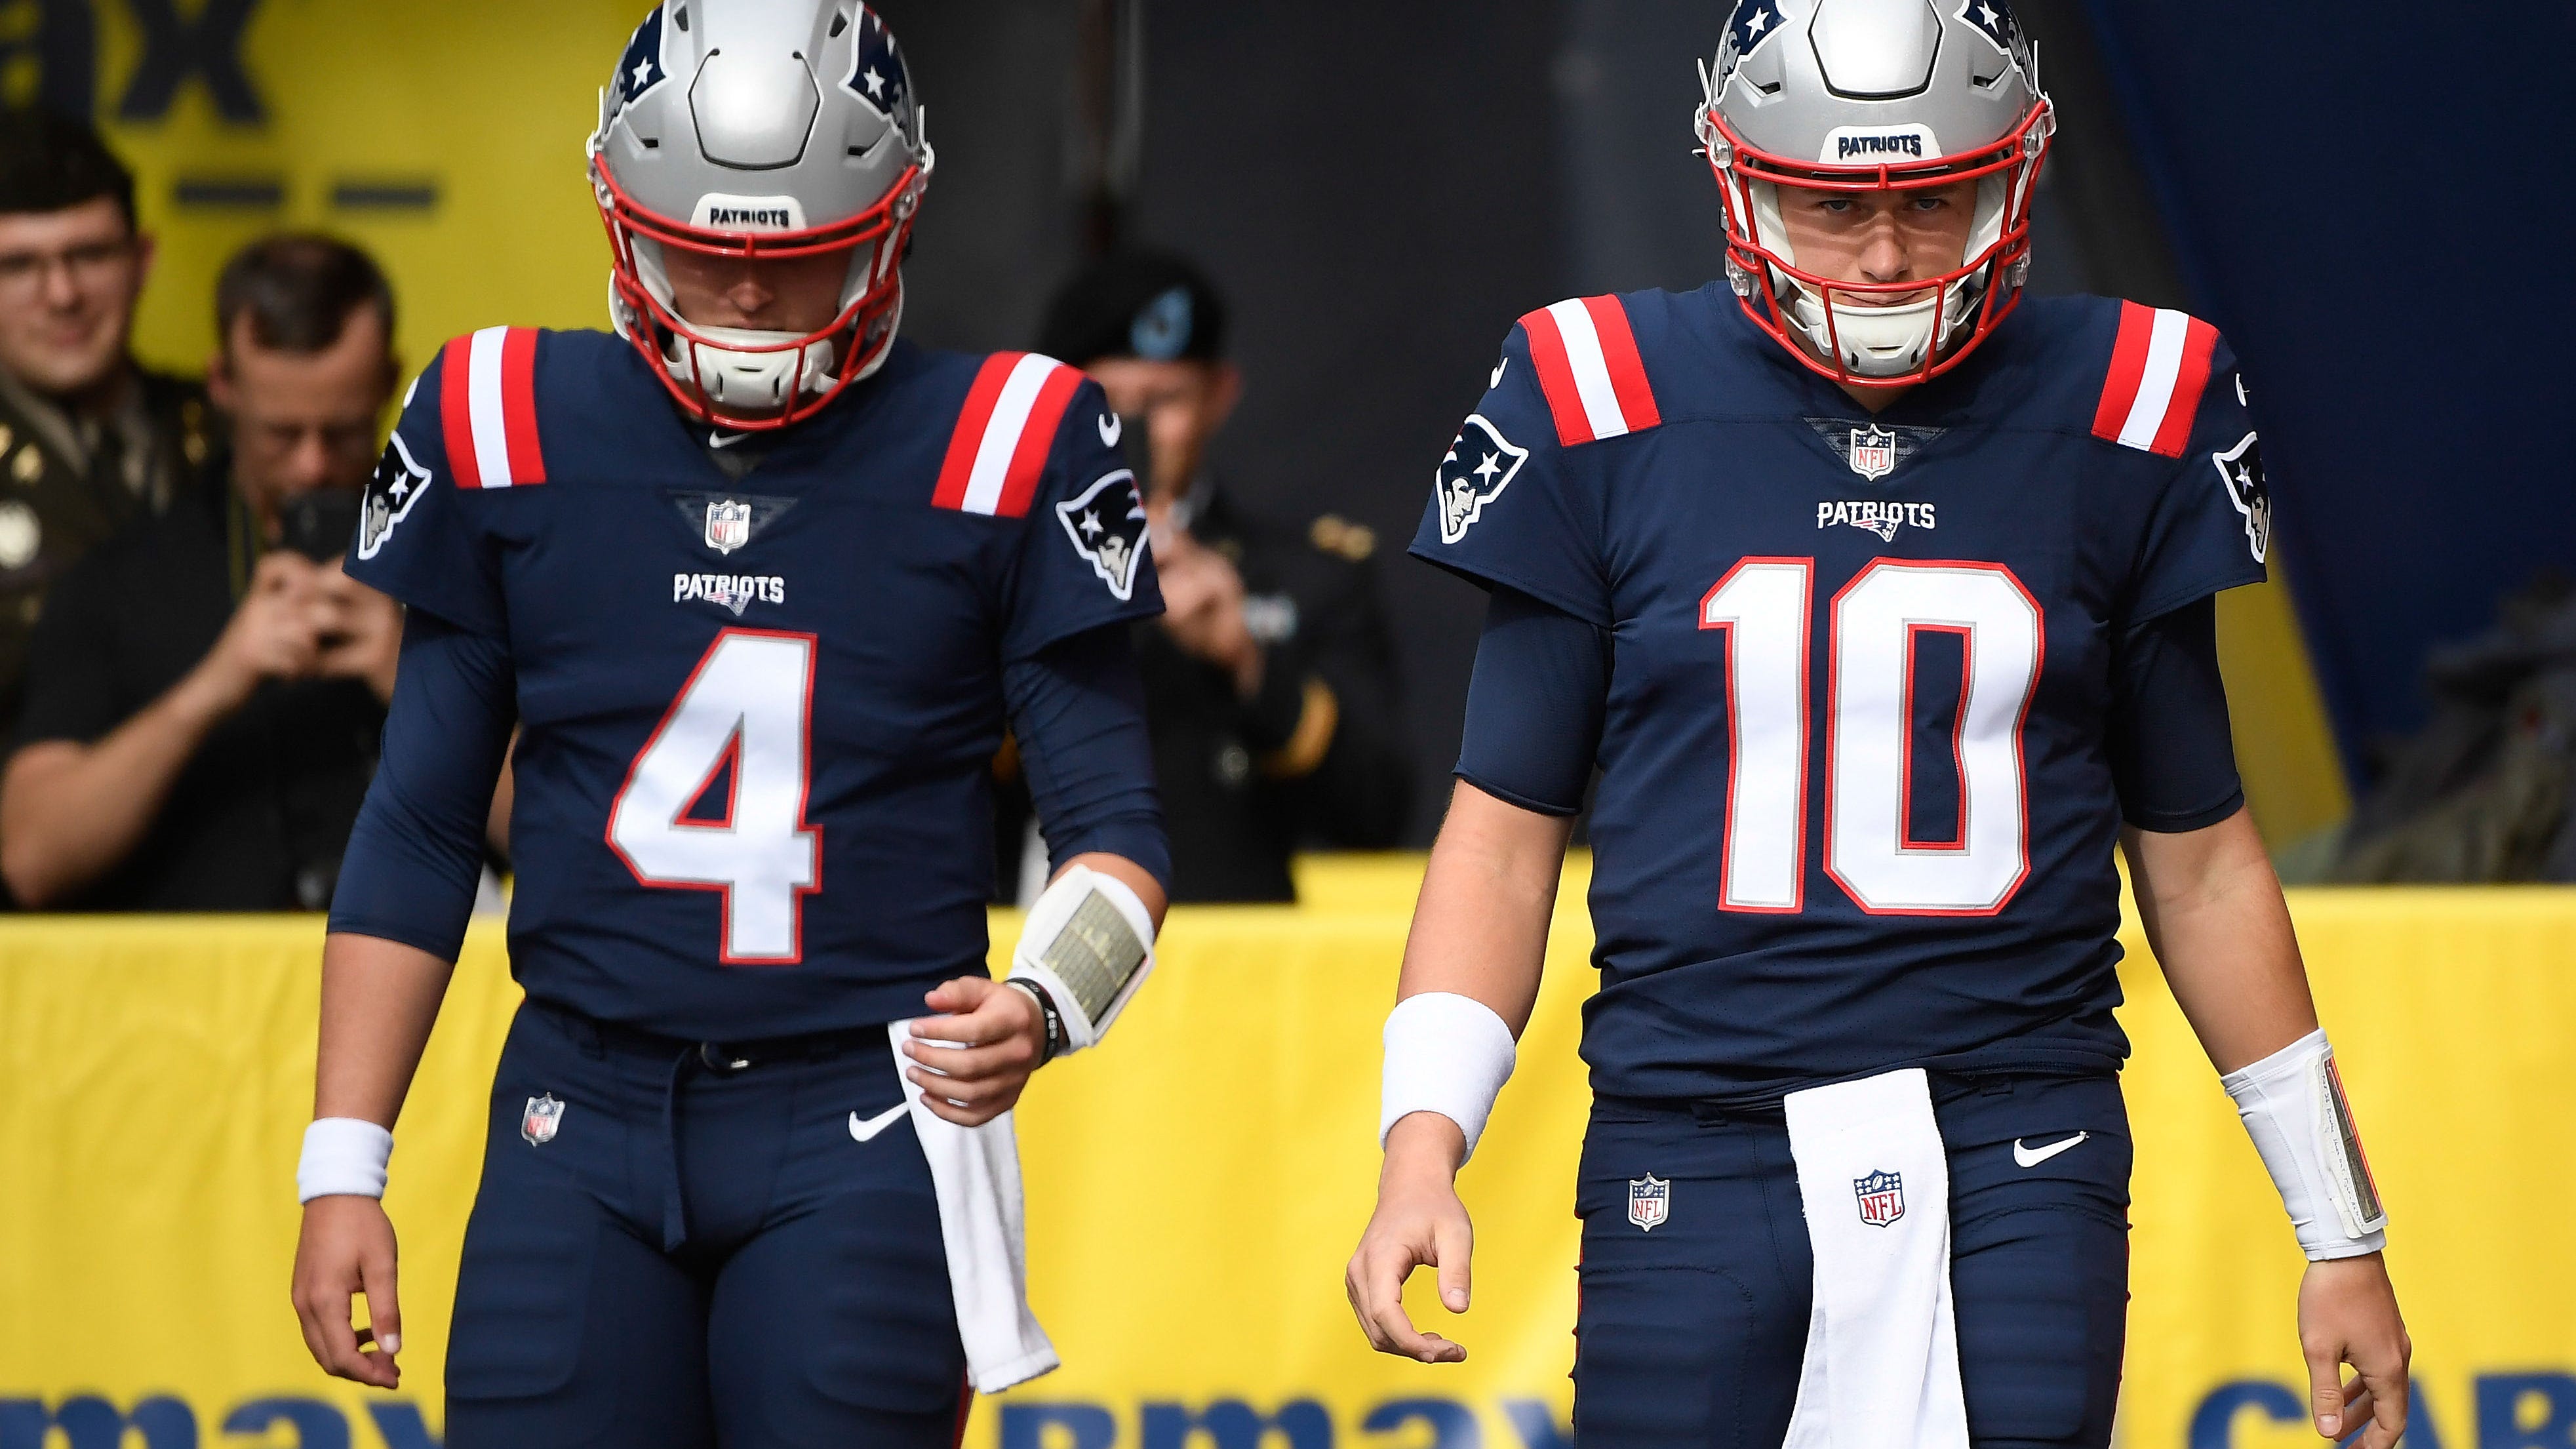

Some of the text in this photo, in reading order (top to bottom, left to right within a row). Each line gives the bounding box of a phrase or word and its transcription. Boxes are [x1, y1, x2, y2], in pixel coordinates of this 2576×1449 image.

[1838, 134, 1921, 160] PATRIOTS
[710, 207, 789, 229] PATRIOTS
[1857, 448, 1887, 470] NFL
[1816, 502, 1935, 529] PATRIOTS
[673, 574, 784, 604] PATRIOTS
[1698, 555, 2045, 916] 10
[604, 626, 823, 965] 4
[1635, 1200, 1660, 1220] NFL
[1861, 1193, 1901, 1221] NFL
